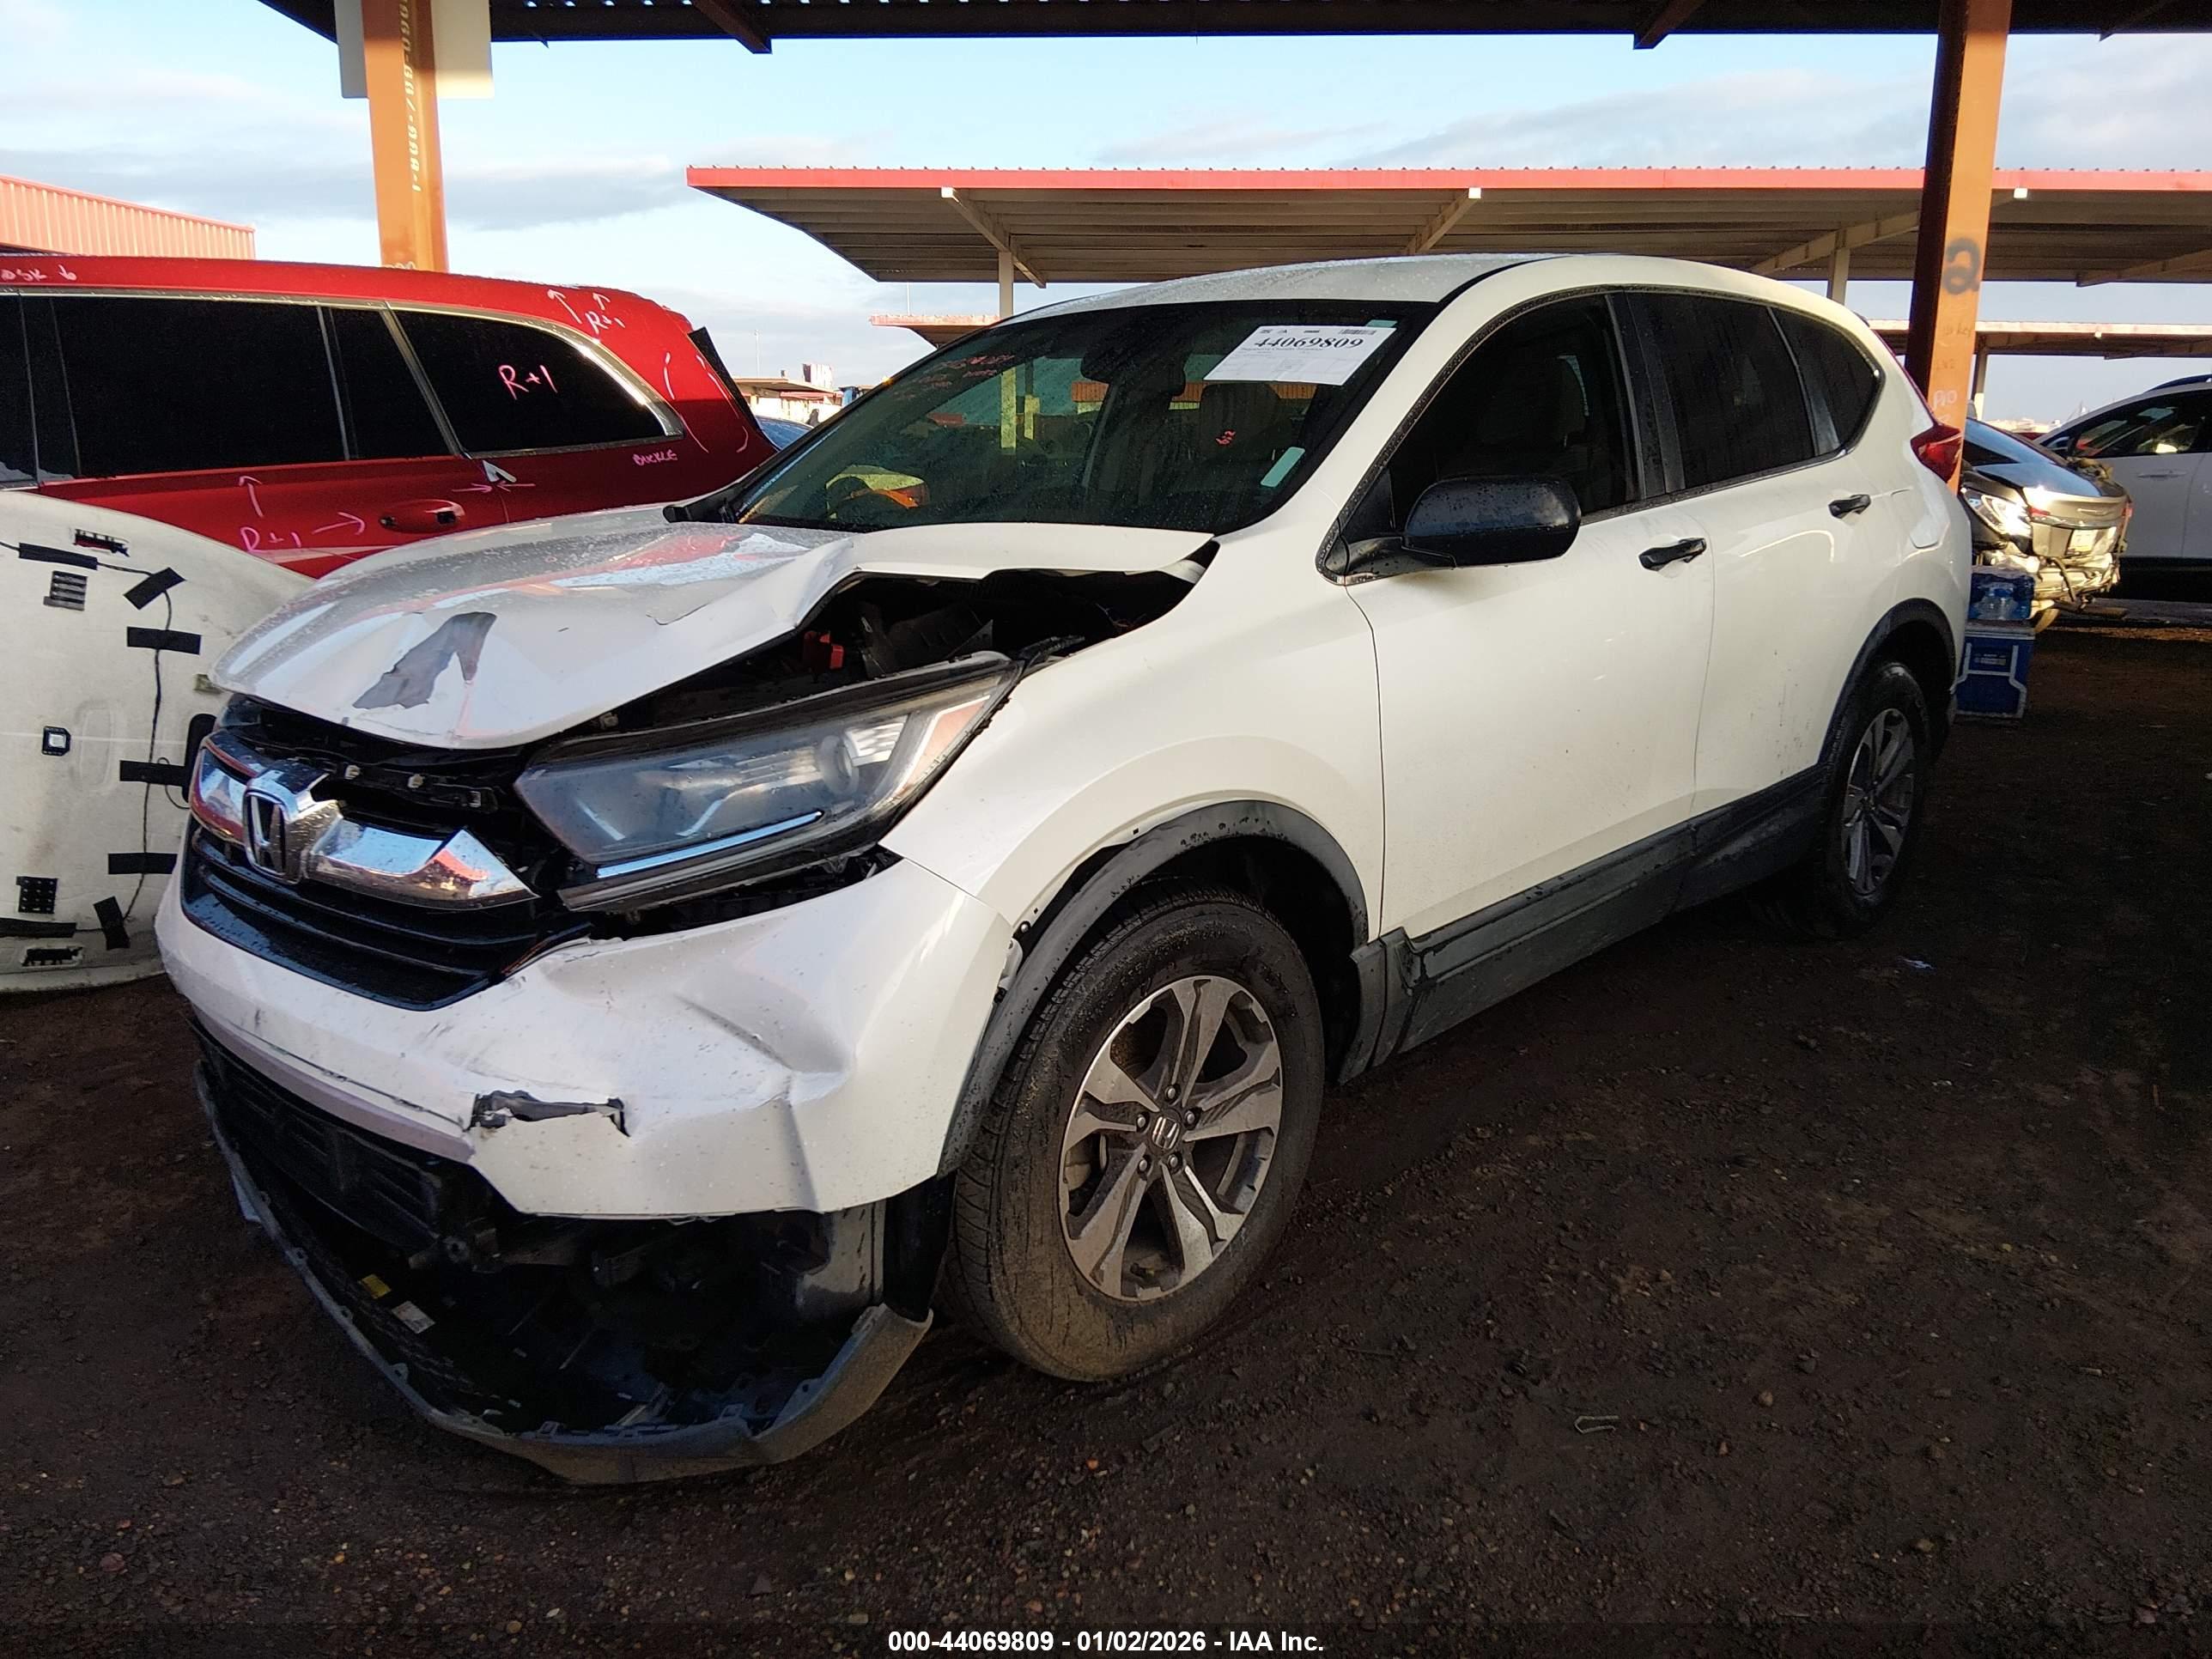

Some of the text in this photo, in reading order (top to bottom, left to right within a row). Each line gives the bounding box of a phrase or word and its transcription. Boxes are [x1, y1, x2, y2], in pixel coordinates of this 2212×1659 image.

[1942, 236, 1982, 296] 2
[1255, 337, 1364, 349] 44069809
[498, 364, 558, 400] R+1
